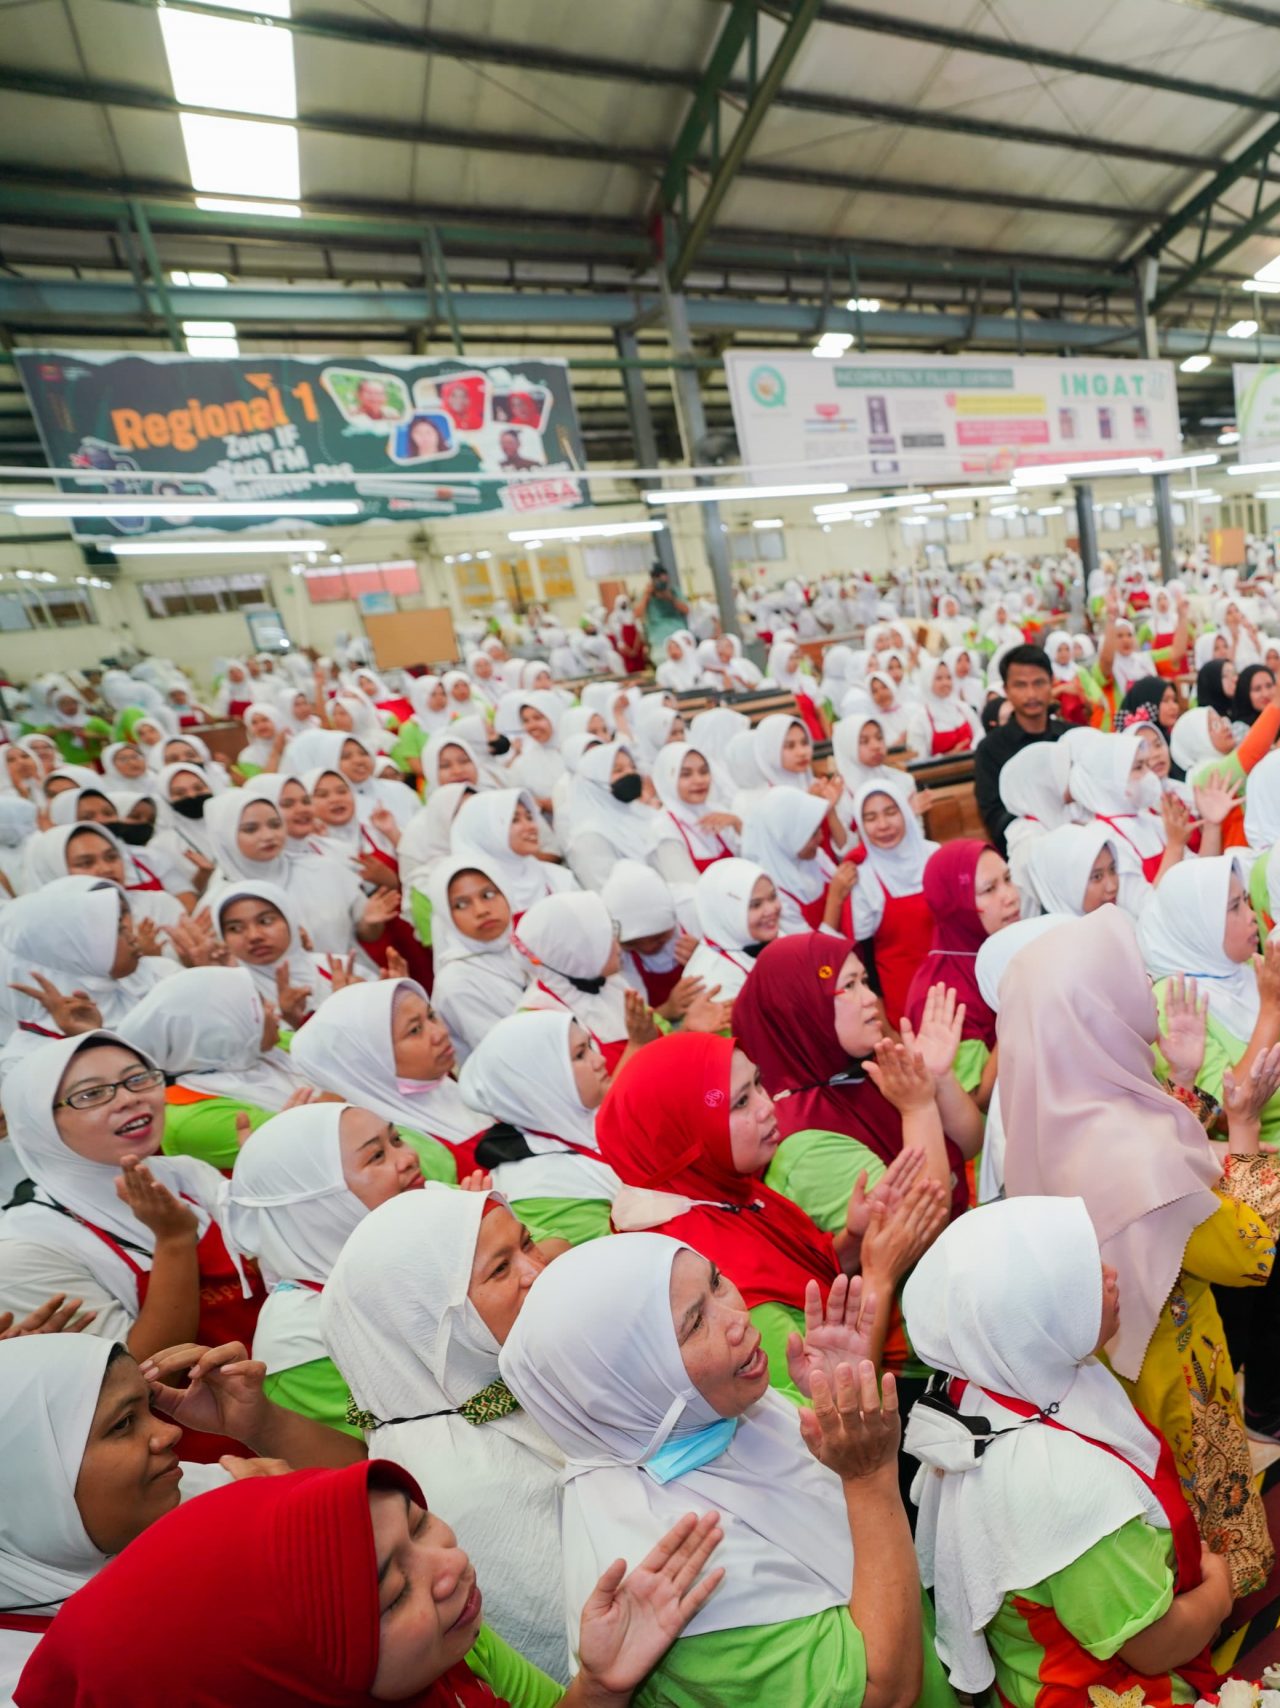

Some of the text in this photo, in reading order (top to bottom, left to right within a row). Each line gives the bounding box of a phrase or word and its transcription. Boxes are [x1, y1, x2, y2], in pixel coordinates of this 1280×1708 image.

[1061, 373, 1144, 396] INGAT
[111, 385, 289, 452] Regional
[292, 382, 319, 422] 1
[221, 432, 275, 460] Zero
[270, 445, 310, 473] FM
